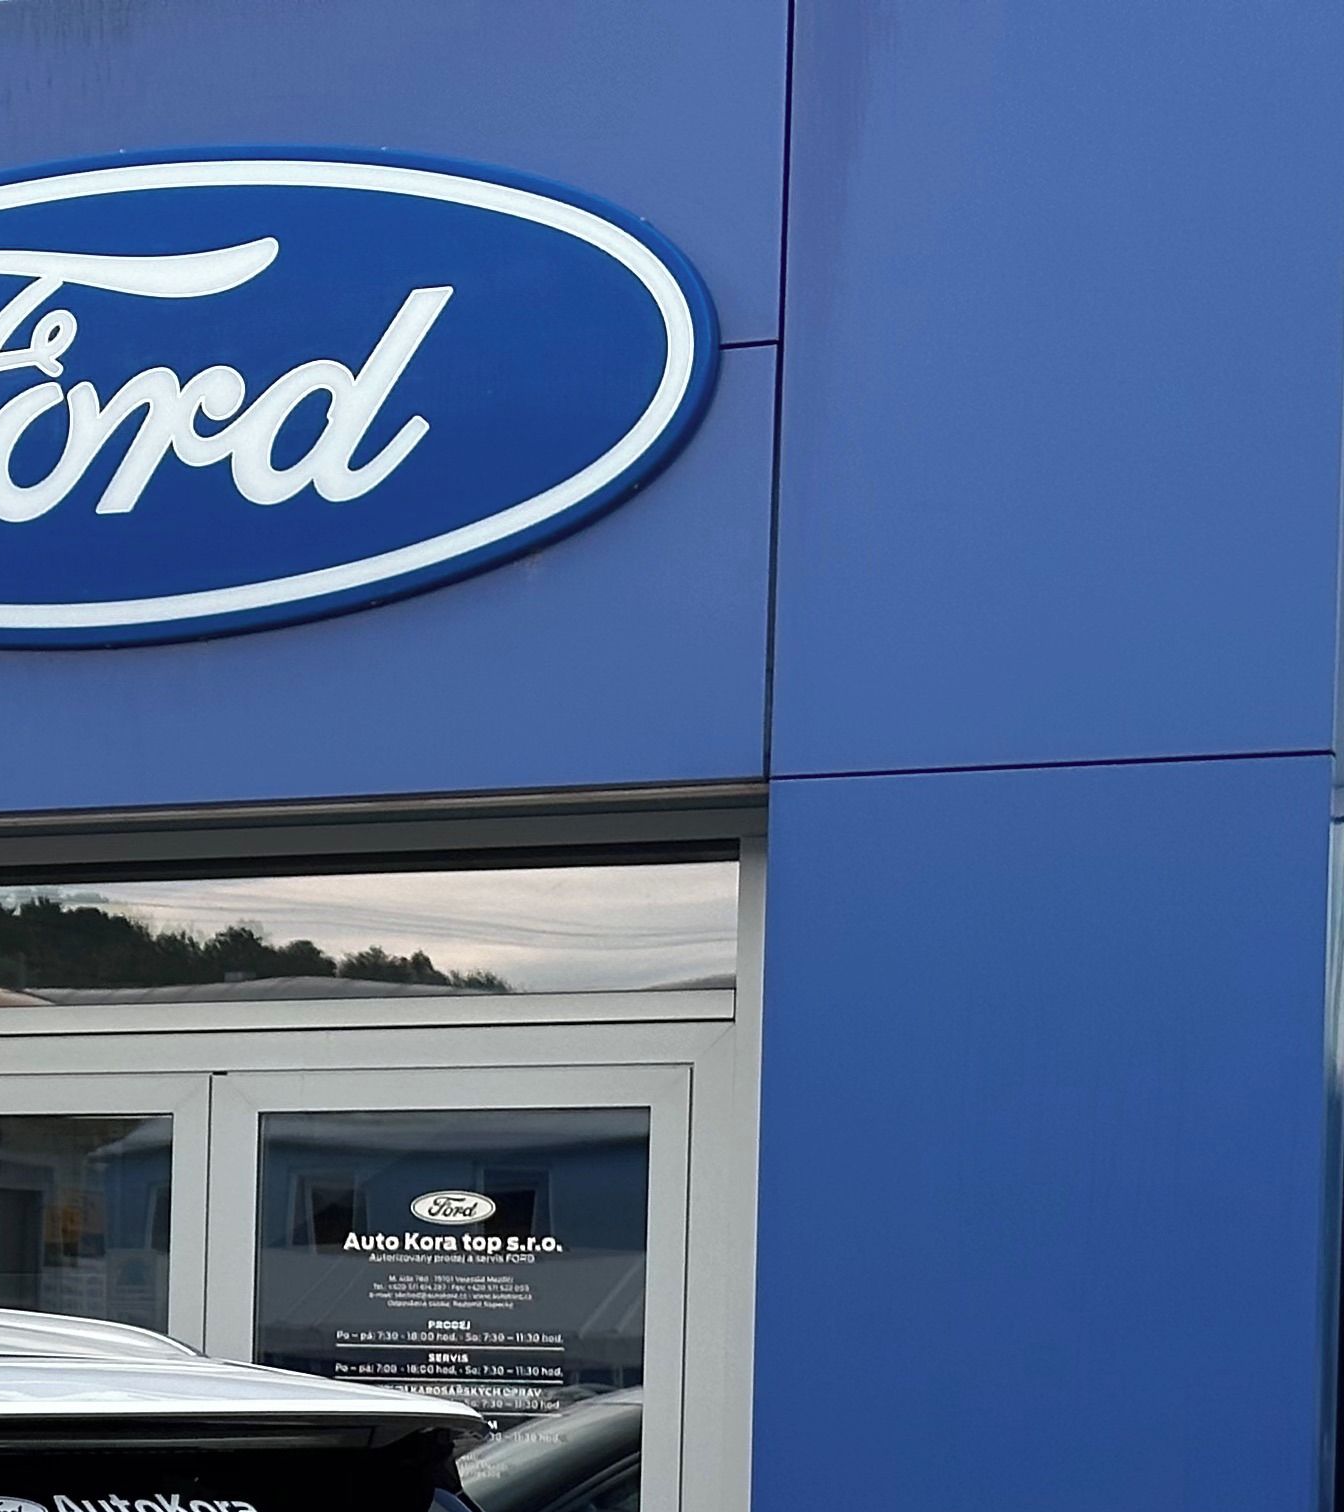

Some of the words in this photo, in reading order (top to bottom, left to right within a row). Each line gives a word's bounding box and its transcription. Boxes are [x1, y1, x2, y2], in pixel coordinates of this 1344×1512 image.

[428, 1197, 477, 1218] Ford
[343, 1232, 399, 1251] Auto
[404, 1233, 457, 1251] Kora
[462, 1233, 502, 1254] top
[506, 1235, 563, 1252] s.r.o.
[377, 1331, 398, 1340] 7:30
[482, 1332, 505, 1342] 7:30
[428, 1353, 469, 1362] SERVIS
